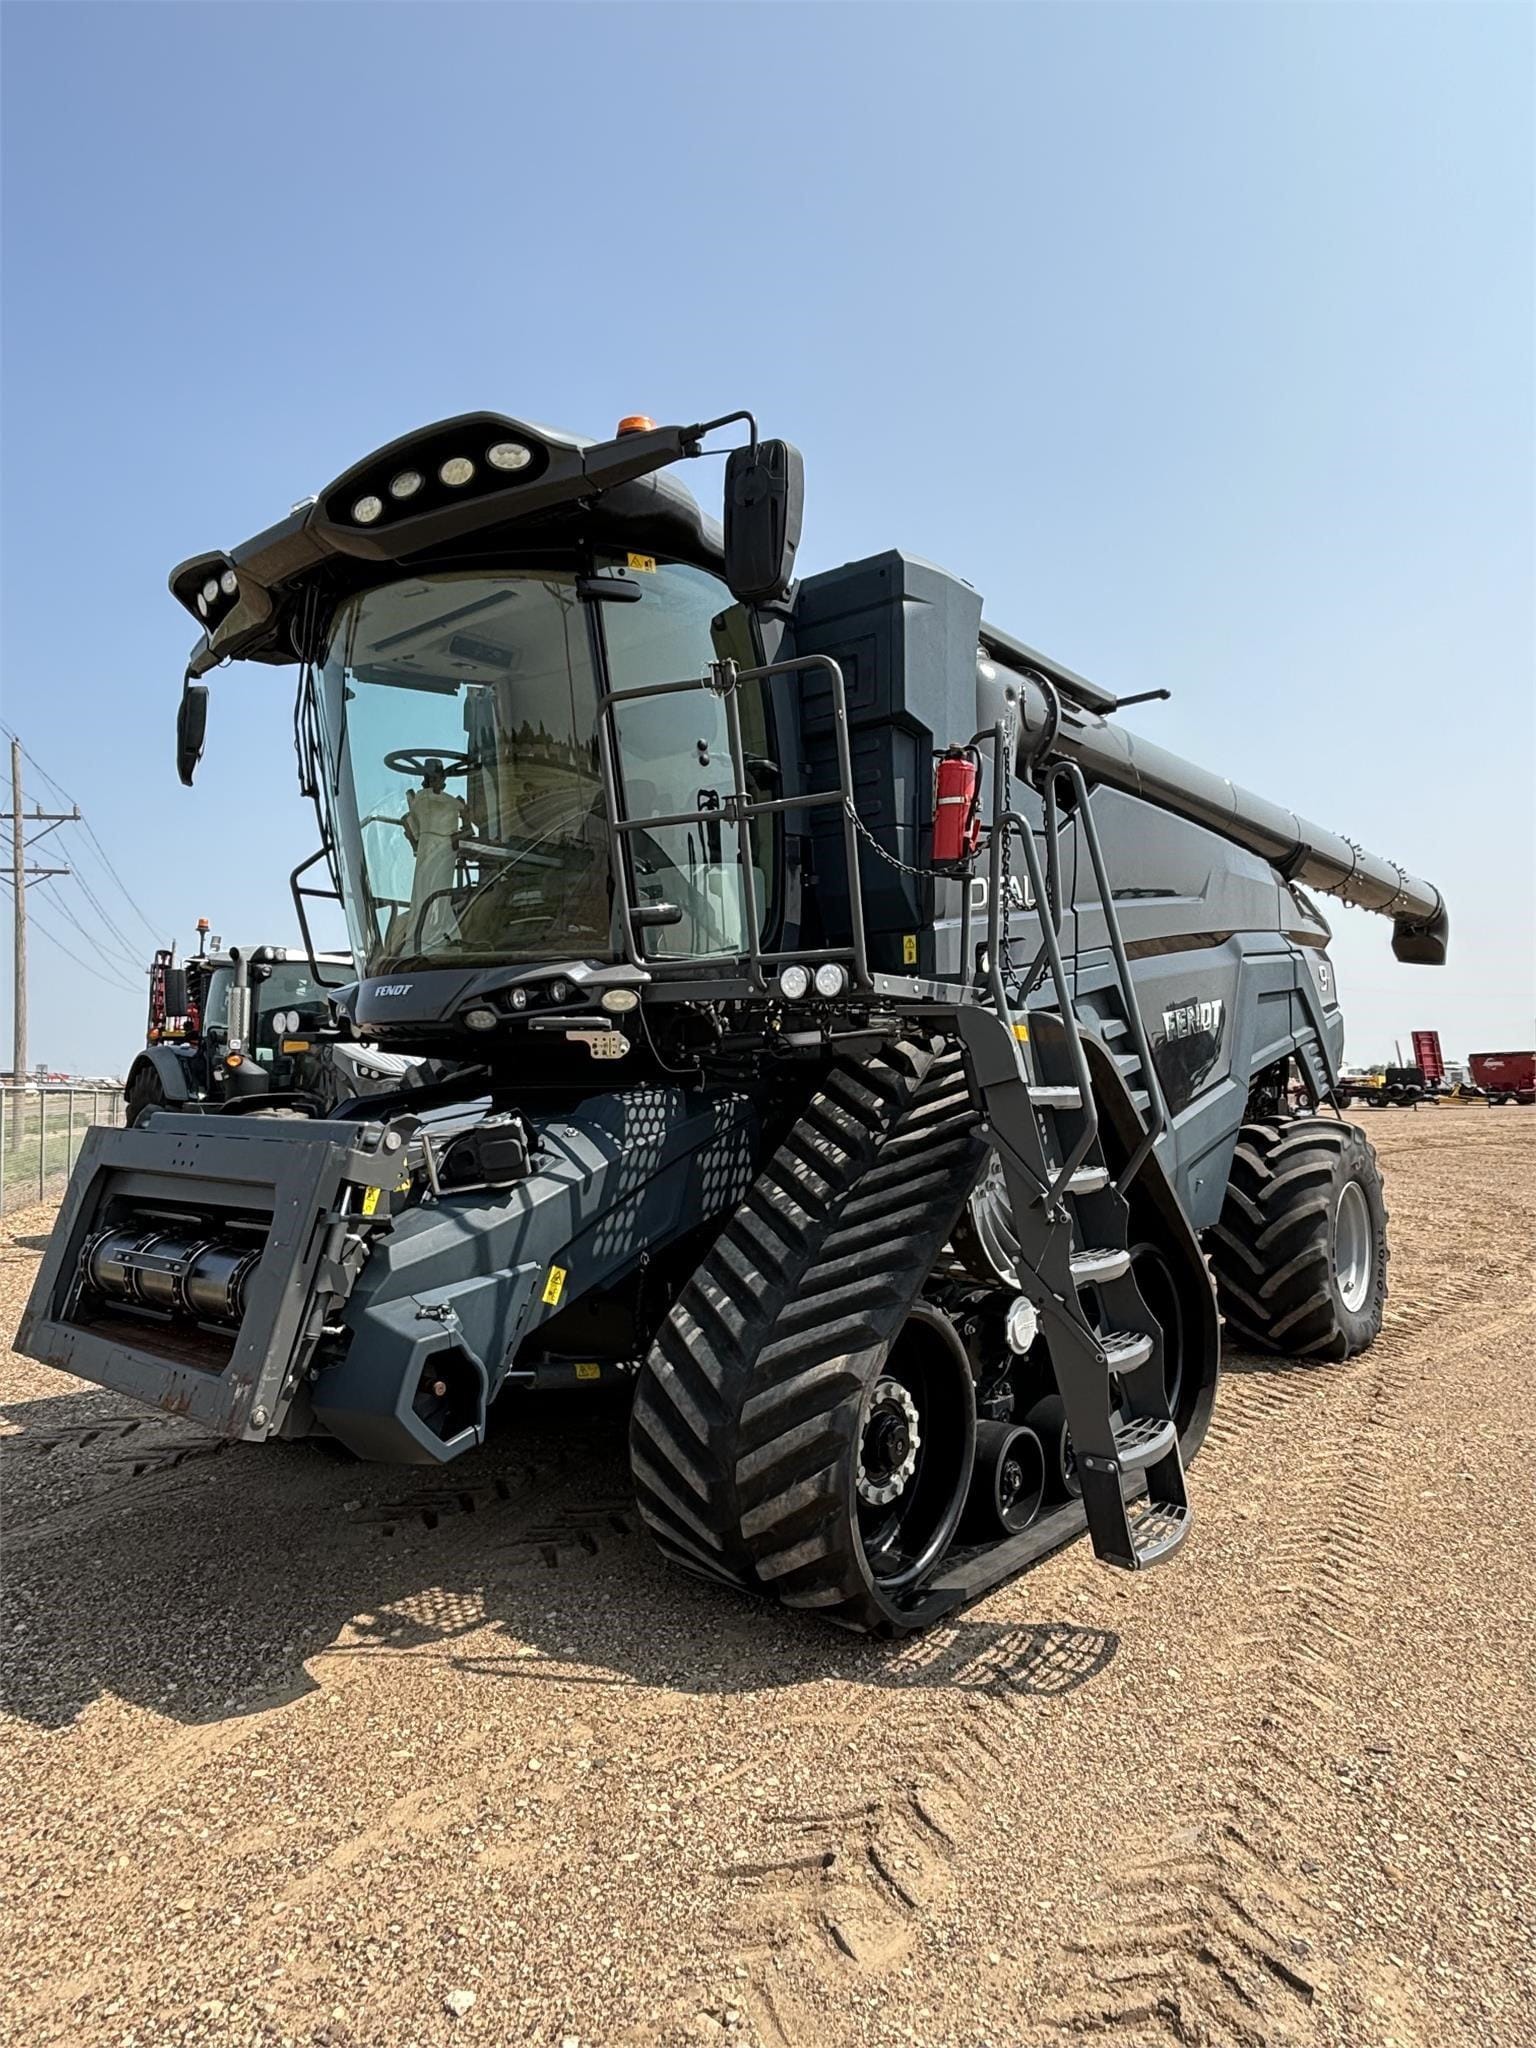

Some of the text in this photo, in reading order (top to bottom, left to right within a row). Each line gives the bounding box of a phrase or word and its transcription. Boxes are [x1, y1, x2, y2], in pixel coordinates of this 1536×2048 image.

[968, 874, 1037, 908] DAL
[374, 984, 414, 997] FENDT
[1161, 999, 1223, 1042] FENDT
